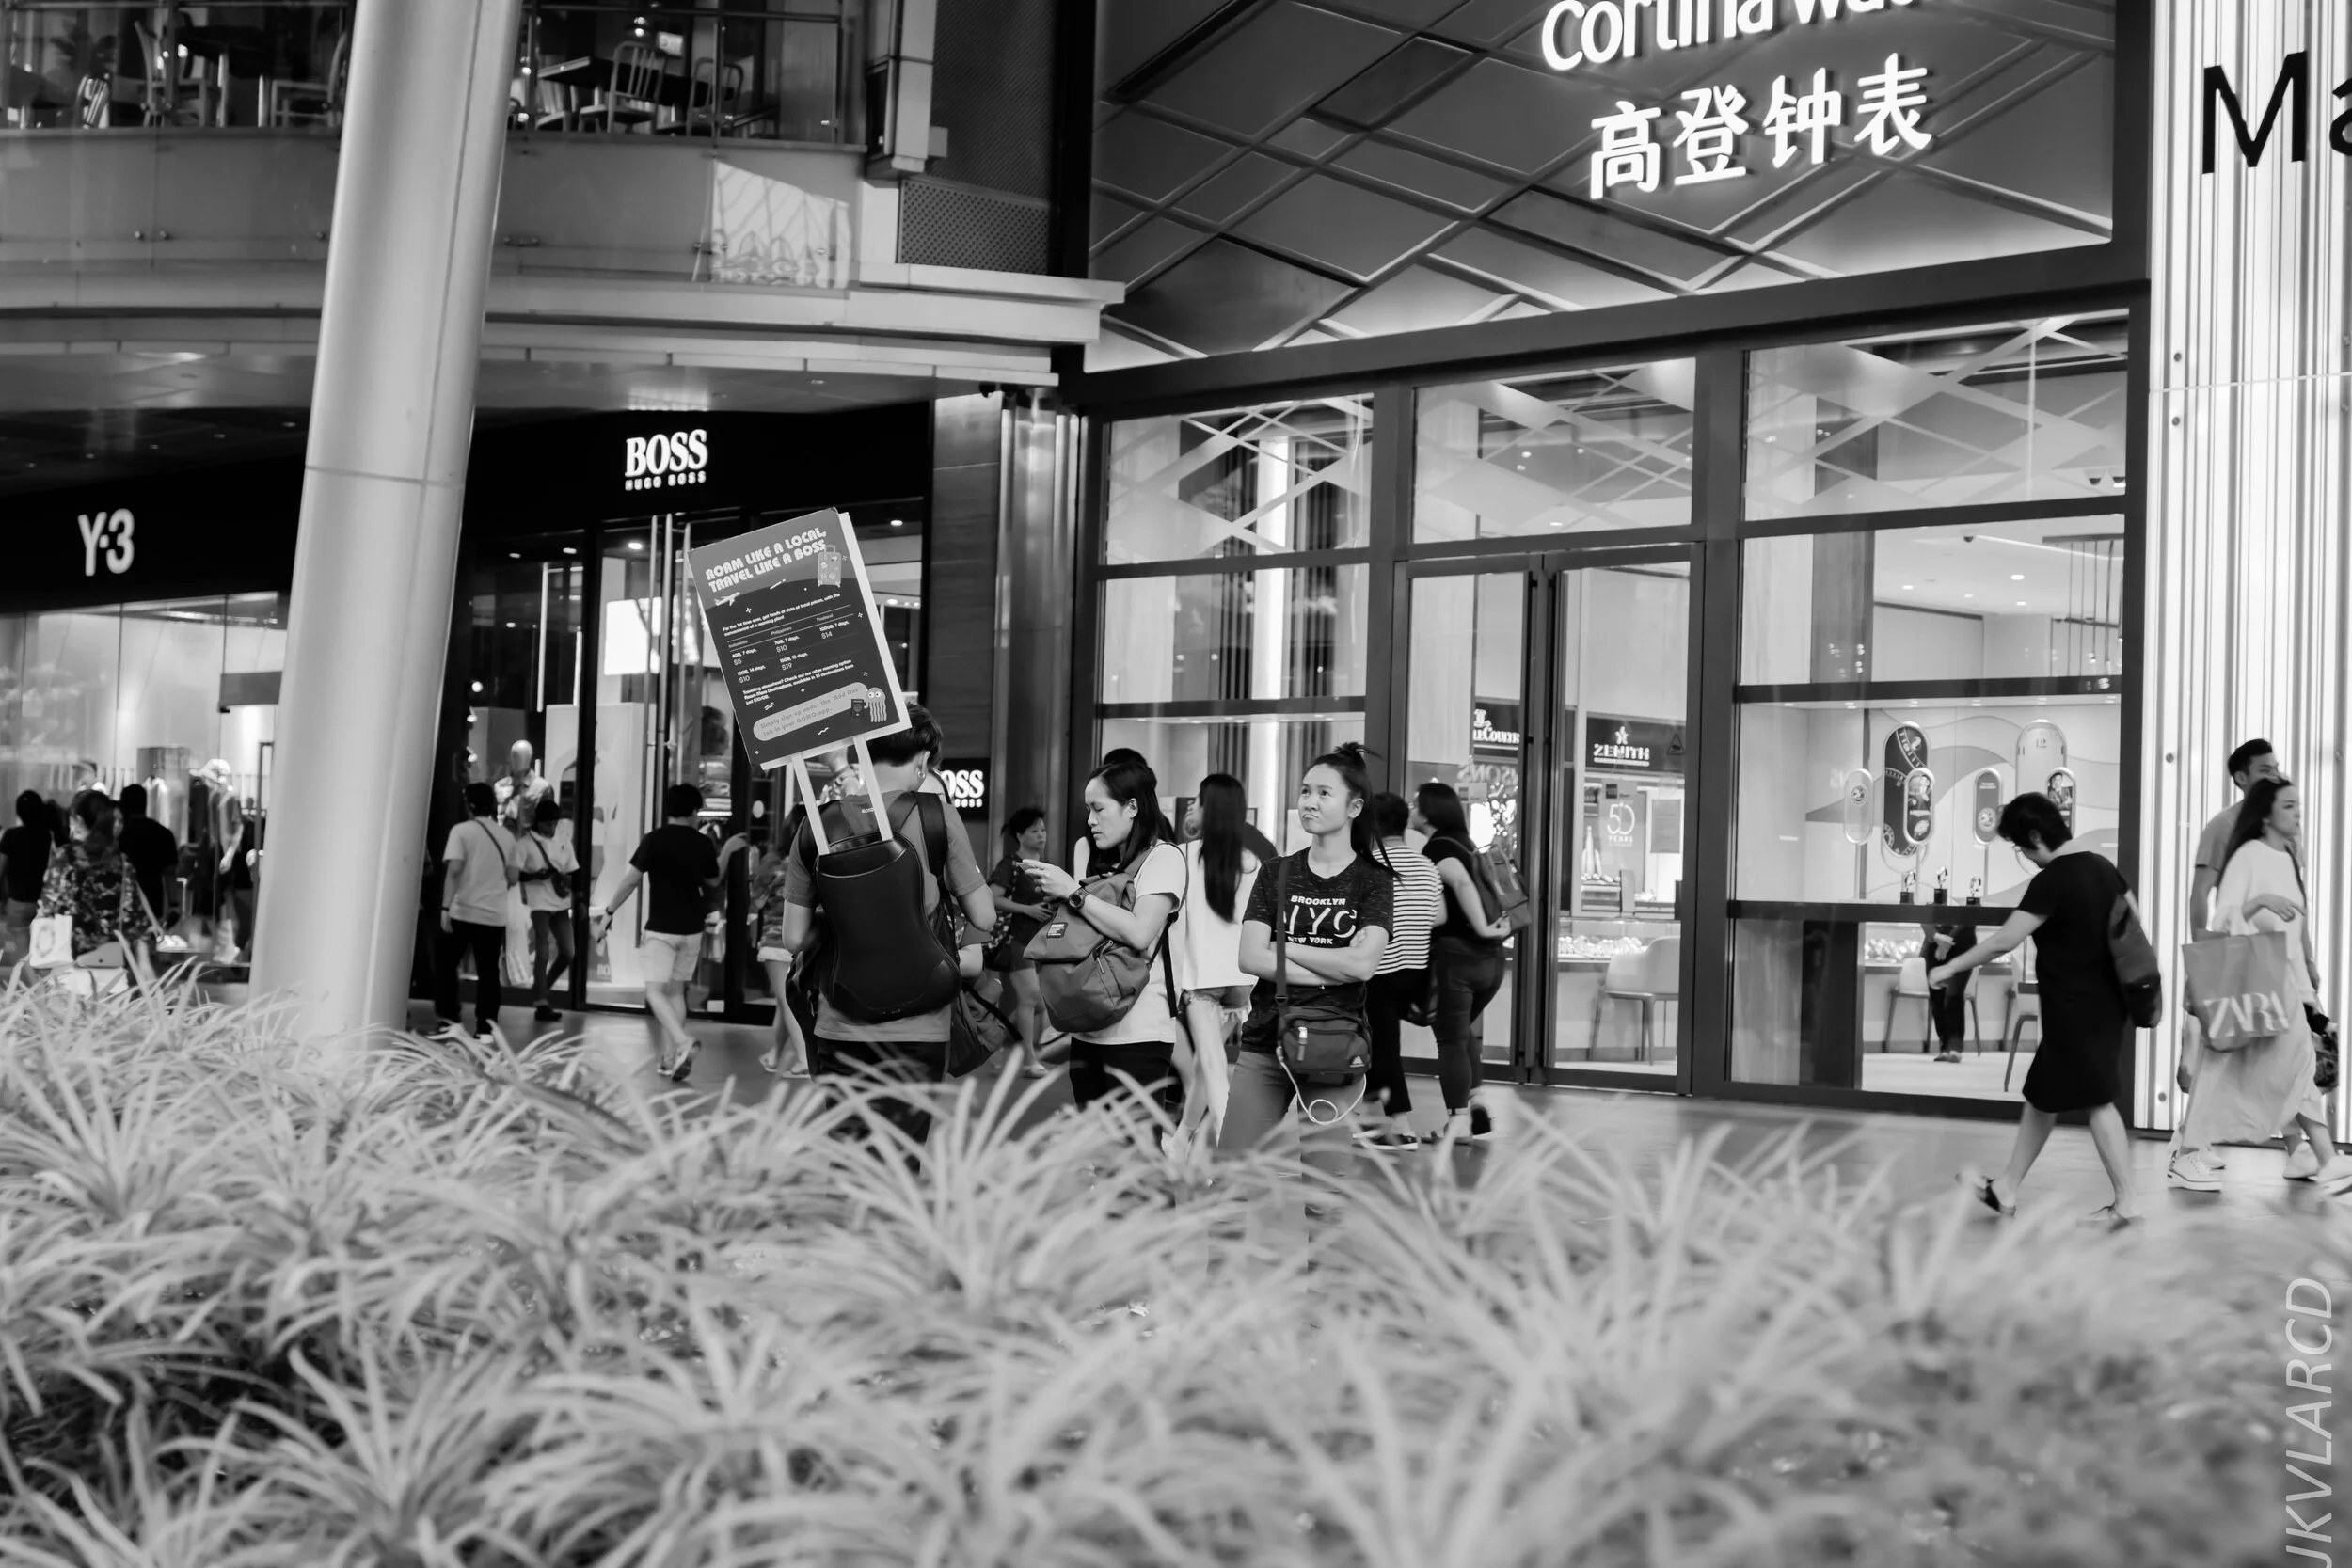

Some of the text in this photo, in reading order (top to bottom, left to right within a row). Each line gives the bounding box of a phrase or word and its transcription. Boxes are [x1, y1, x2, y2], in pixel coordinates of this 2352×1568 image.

[1590, 53, 1932, 199] 高登钟表
[625, 428, 708, 477] BOSS
[625, 470, 707, 491] HUGO BOSS
[706, 528, 826, 580] ROAM LIKE A LOCAL,
[708, 539, 826, 593] TRAVEL LIKE A BOSS
[776, 644, 787, 653] $10
[1593, 743, 1650, 760] ZENITH
[941, 769, 985, 799] OSS
[1291, 895, 1346, 906] BROOKLYN
[1287, 936, 1333, 945] NEW YORK
[2202, 990, 2290, 1039] ZARA
